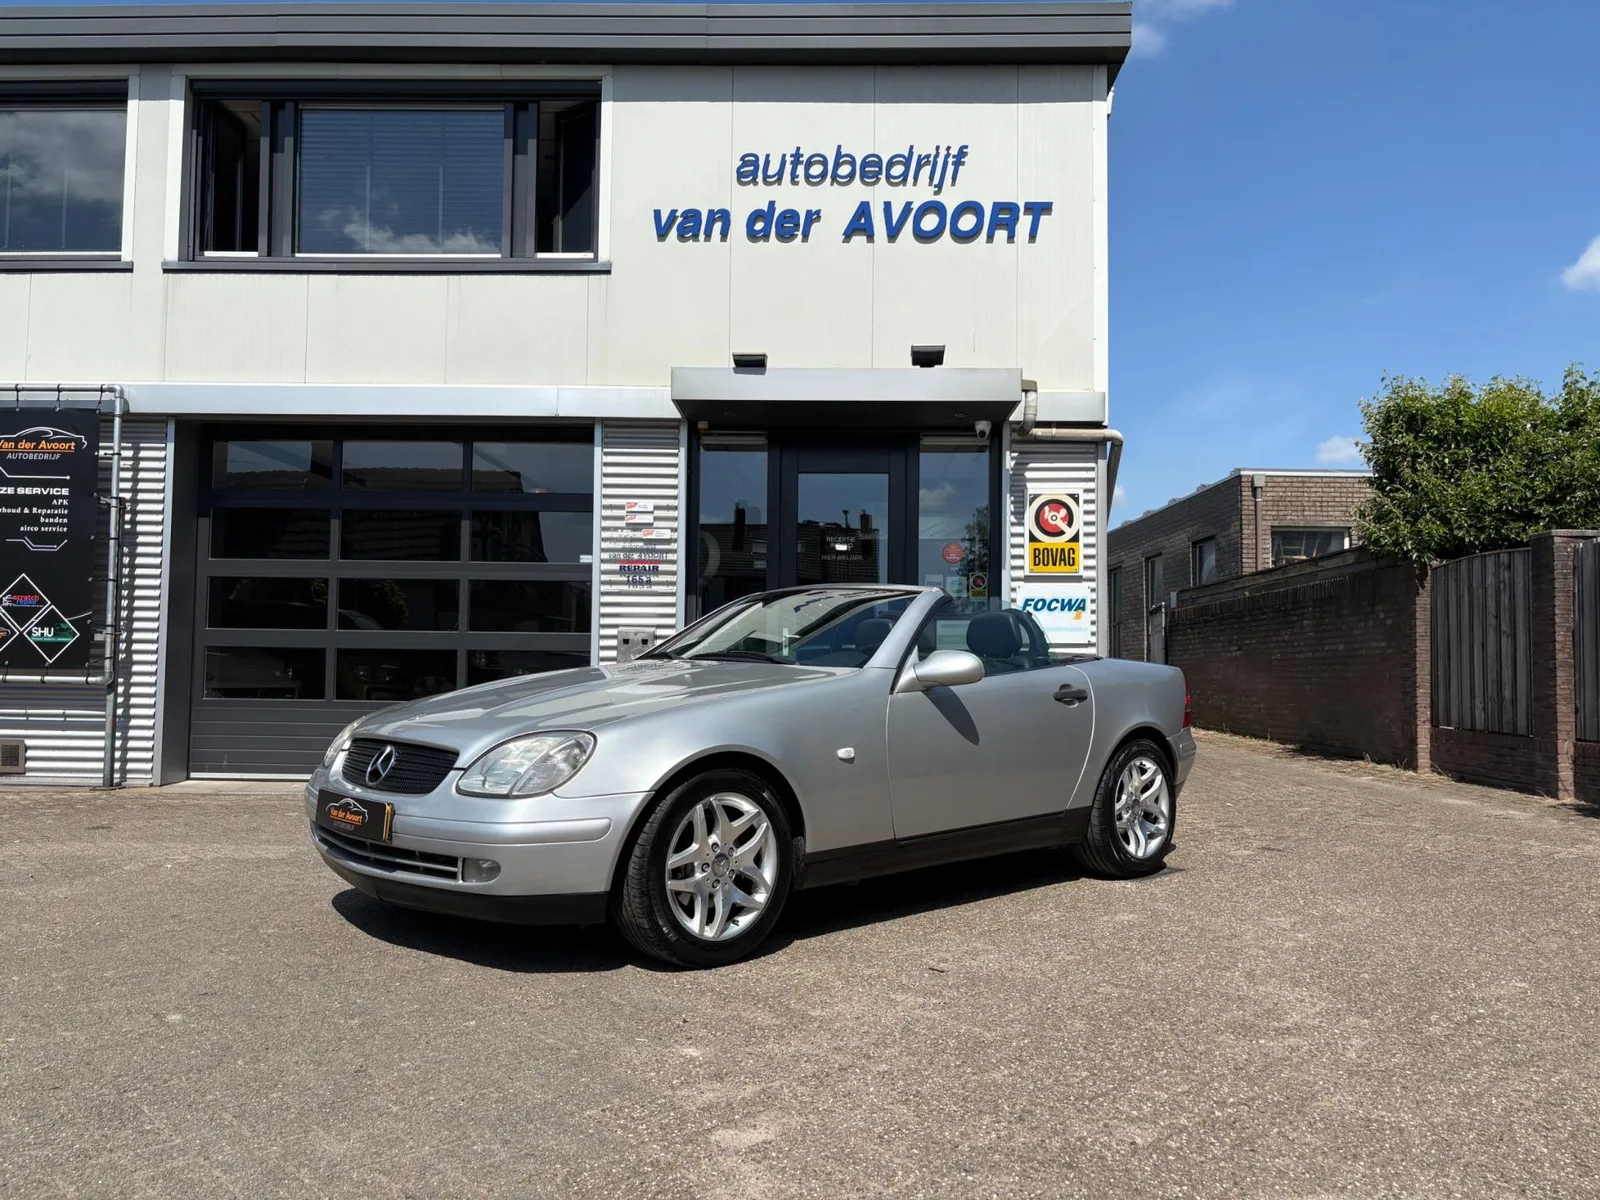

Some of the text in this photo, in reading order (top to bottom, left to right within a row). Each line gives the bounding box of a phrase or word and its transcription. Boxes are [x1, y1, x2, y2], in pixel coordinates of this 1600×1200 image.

[736, 144, 968, 192] autobedrijf
[653, 200, 1053, 240] van der AVOORT
[17, 439, 36, 449] der
[38, 440, 76, 450] Avoort
[6, 452, 61, 460] AUTOBEDRIJF
[17, 487, 70, 495] SERVICE
[32, 507, 69, 516] Reparatie
[1033, 547, 1076, 567] BOVAG
[1022, 598, 1087, 612] FOCWA
[31, 626, 54, 637] SHU
